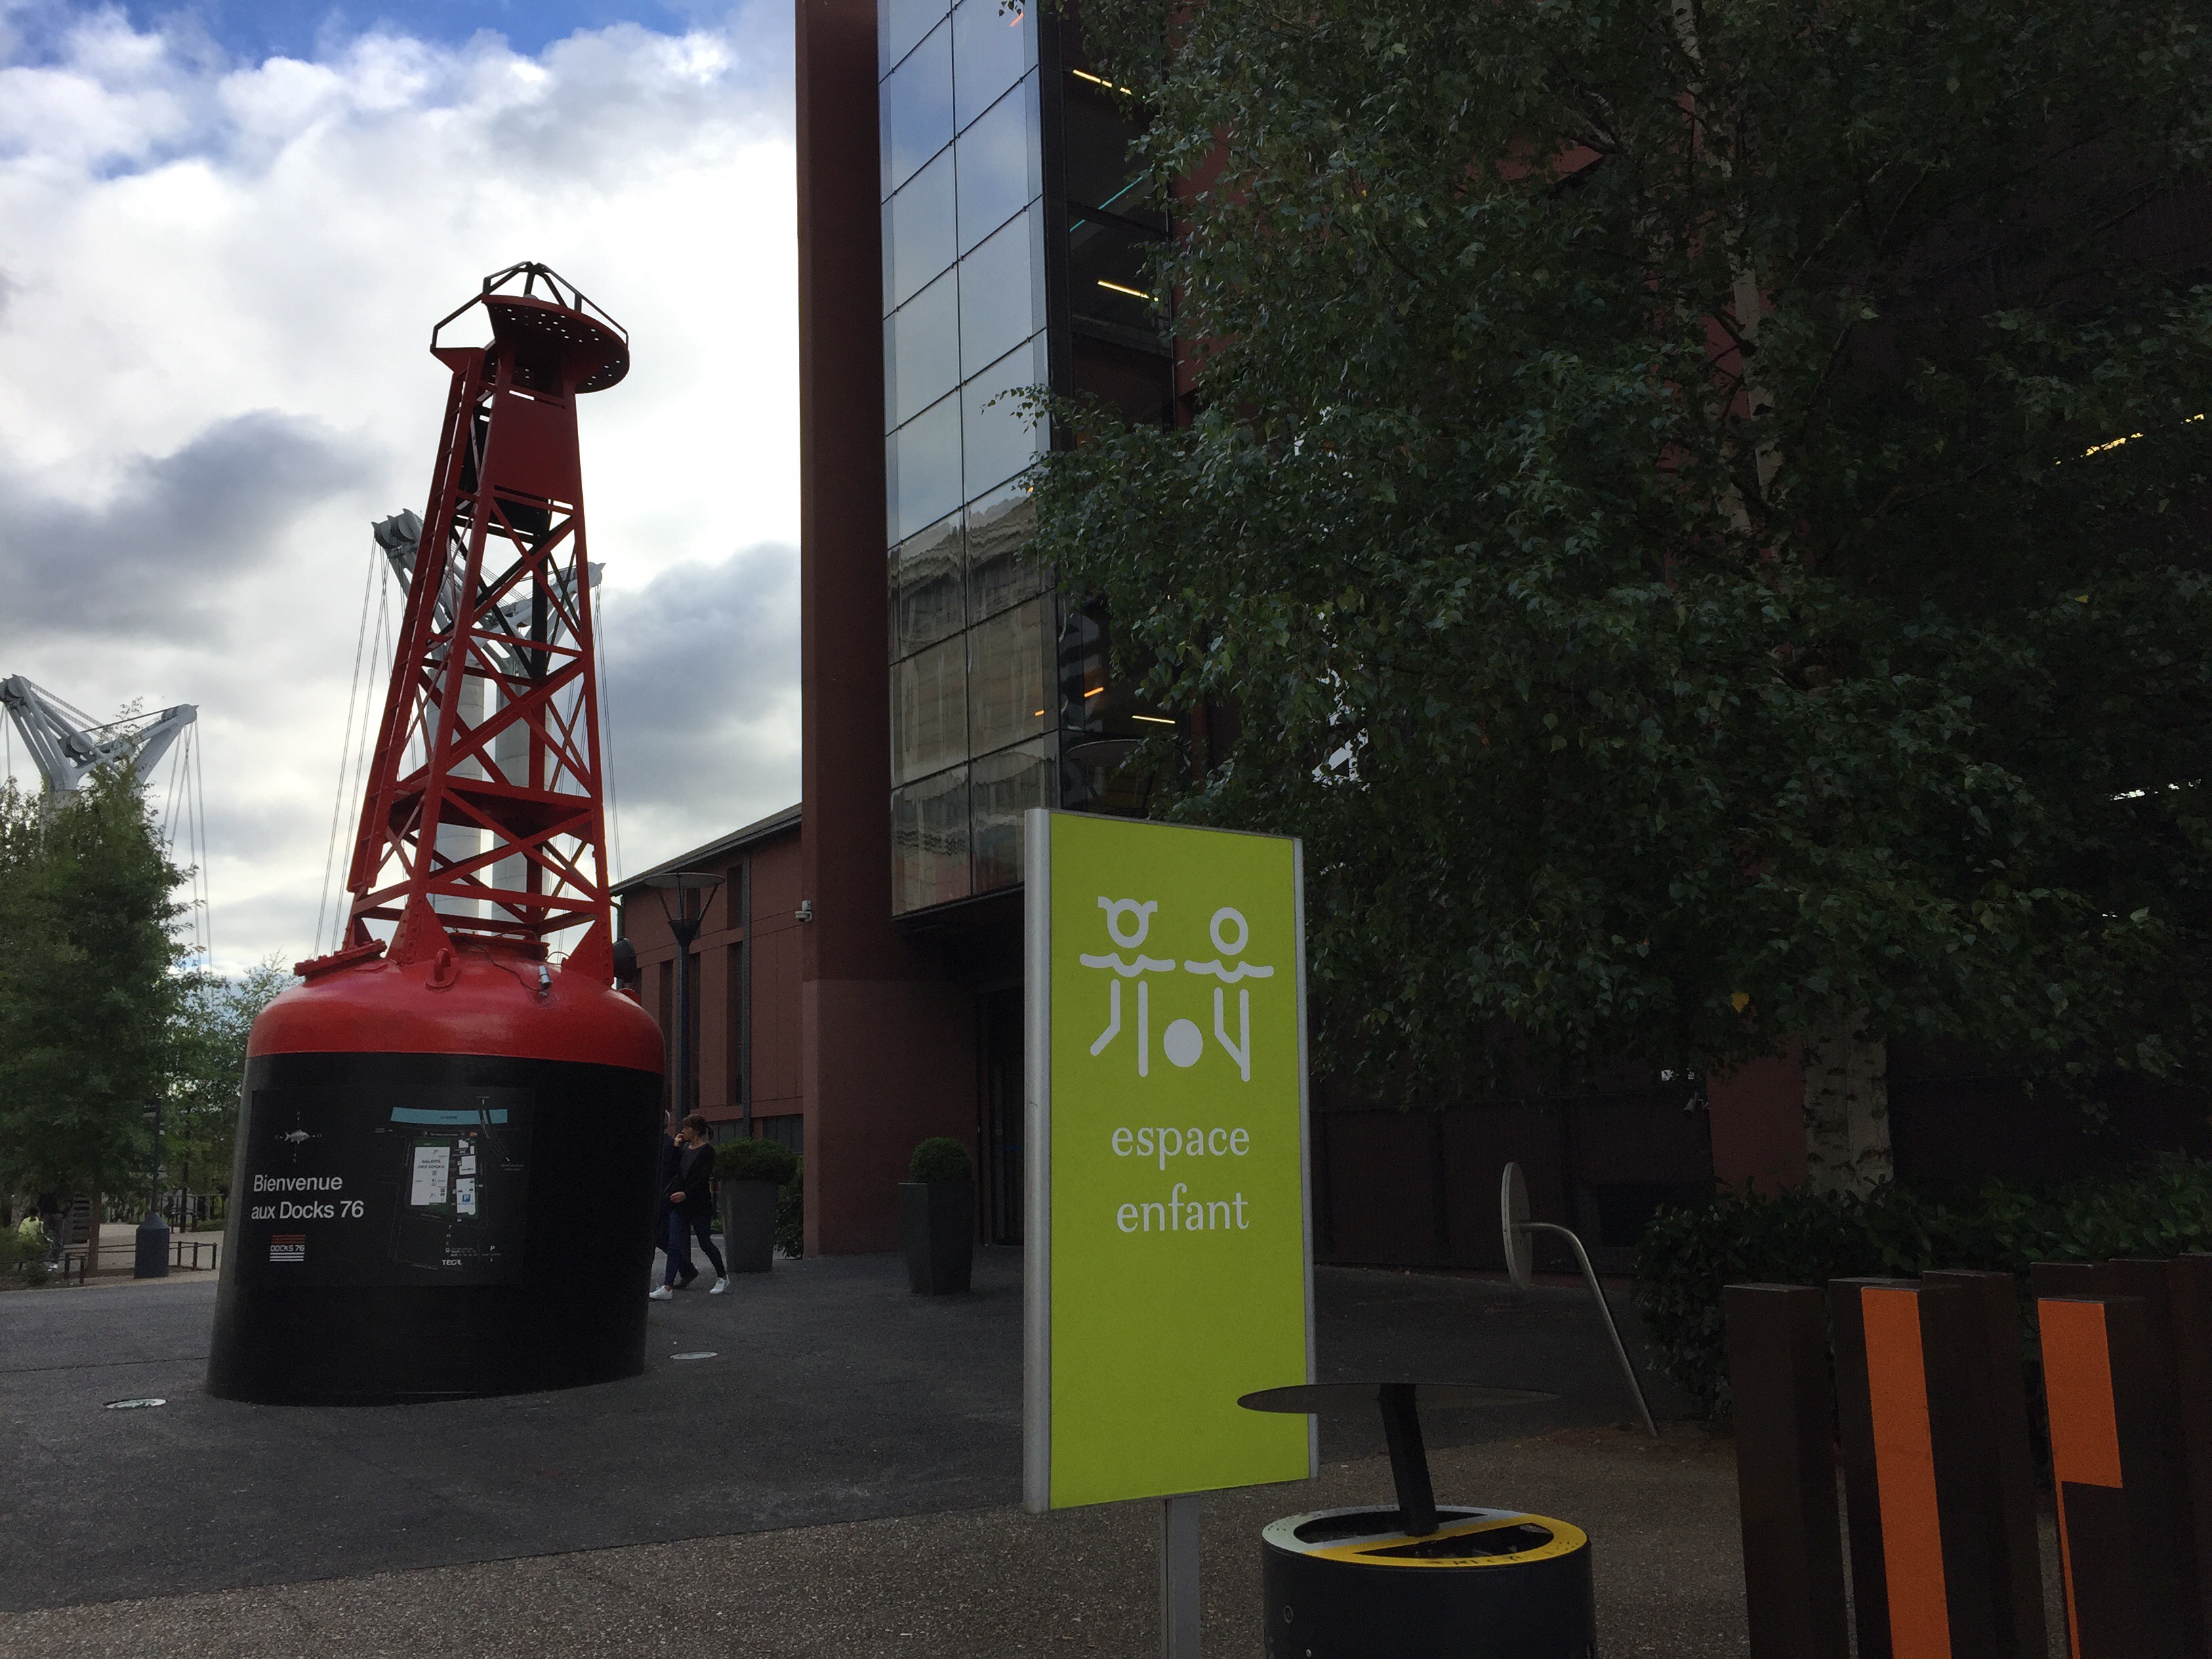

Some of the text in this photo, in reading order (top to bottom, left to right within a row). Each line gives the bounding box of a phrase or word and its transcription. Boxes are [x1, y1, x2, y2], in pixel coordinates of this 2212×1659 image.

[1111, 1126, 1250, 1170] espace
[253, 1174, 343, 1192] Bienvenue
[251, 1200, 365, 1220] aux Docks 76
[1117, 1183, 1249, 1233] enfant
